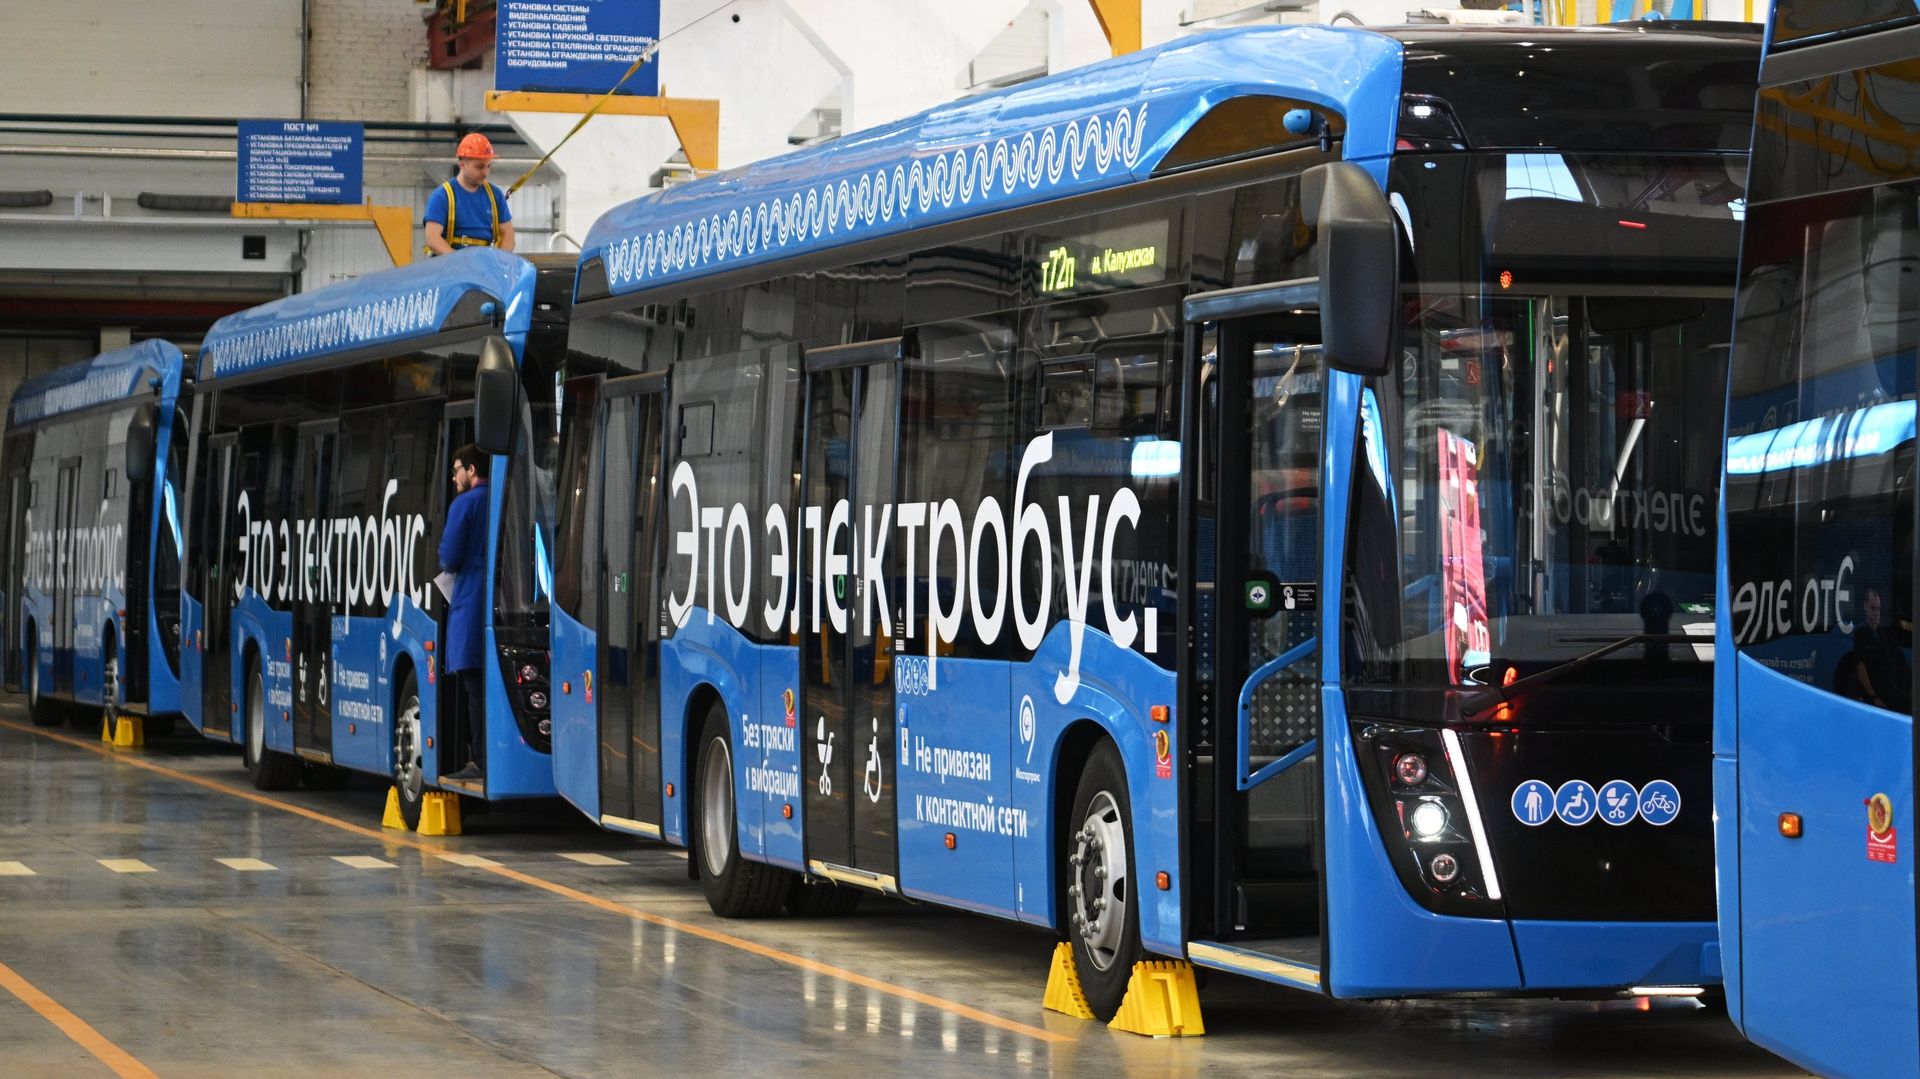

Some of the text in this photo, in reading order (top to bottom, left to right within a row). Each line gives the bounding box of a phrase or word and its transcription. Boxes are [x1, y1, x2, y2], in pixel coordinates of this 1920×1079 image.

[508, 2, 590, 13] УСТАНОВКА СИСТЕМЫ
[509, 12, 586, 22] ВИДЕОНАБЛЮДЕНИЯ
[508, 21, 588, 31] УСТАНОВКА СИДЕНИЙ
[507, 31, 652, 44] УСТАНОВКА НАРУЖНОЙ СВЕТОТЕХНИКИ
[507, 40, 648, 53] УСТАНОВКА СТЕКЛЯННЫХ ОГРАЖДЕ
[507, 50, 550, 59] УСТАНОВКА
[551, 51, 603, 60] ОГРАЖДЕНИЯ
[507, 59, 567, 69] ОБОРУДОВАНИЯ
[283, 123, 304, 131] ПОСТ
[284, 134, 322, 142] БАТАРЕЙНЫХ
[323, 135, 352, 143] МОДУЛЕЙ
[283, 142, 343, 150] ПРЕОБРАЗОВАТЕЛЕЙ
[1104, 246, 1155, 274] Калужская
[22, 507, 45, 590] Это
[234, 479, 431, 640] Это электробус.
[668, 430, 1158, 706] Это электробус.
[742, 713, 795, 757] Без тряски
[915, 735, 932, 774] Не
[934, 747, 991, 784] привязан
[751, 759, 799, 801] вибраций
[916, 794, 1027, 838] к контактной сети
